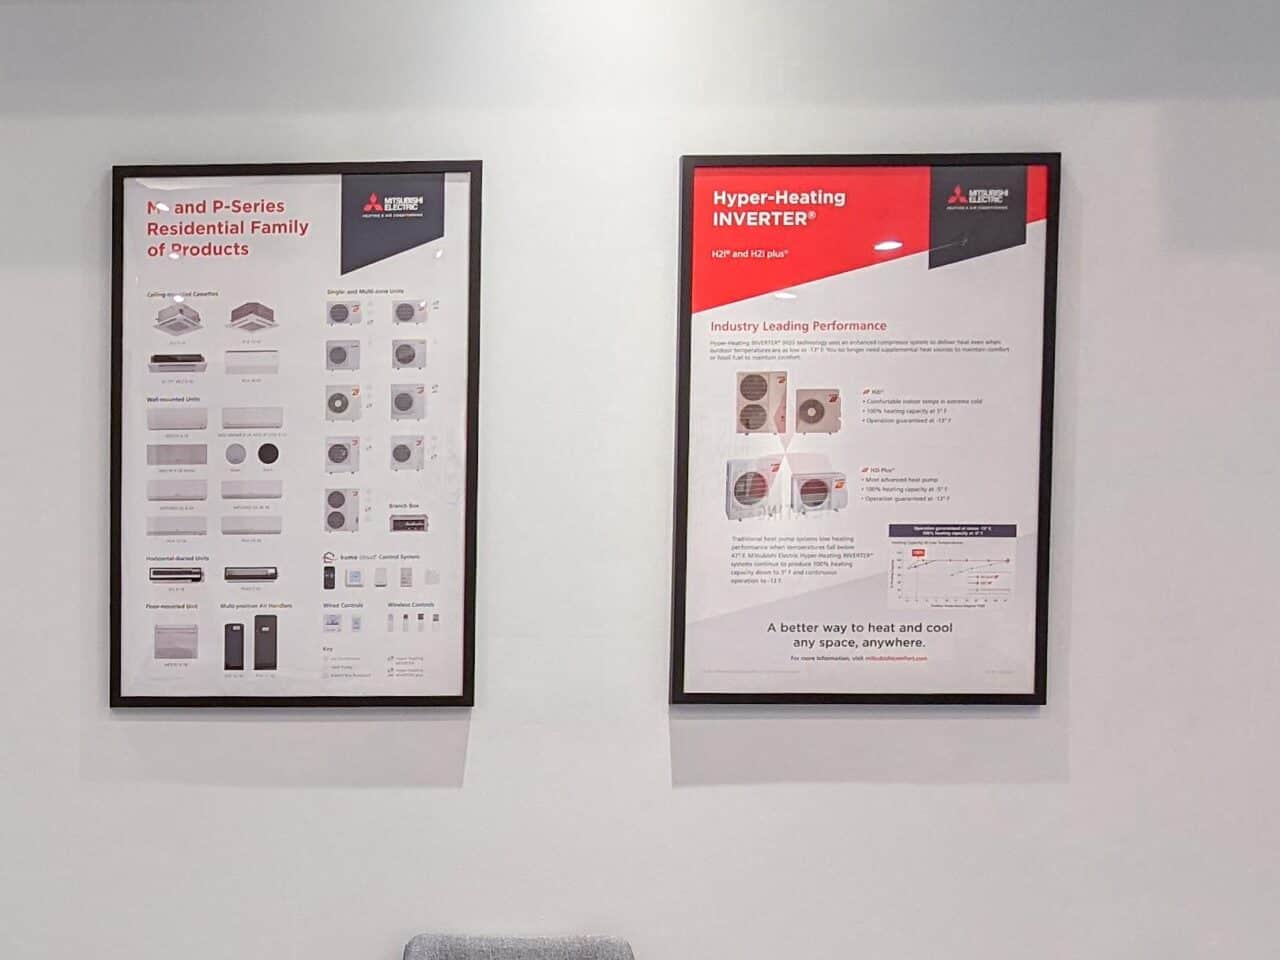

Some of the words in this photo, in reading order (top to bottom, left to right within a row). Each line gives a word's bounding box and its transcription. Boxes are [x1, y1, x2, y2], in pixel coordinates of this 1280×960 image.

[713, 190, 846, 207] Hyper-Heating
[174, 200, 206, 214] and
[213, 199, 285, 213] P-Series
[713, 210, 816, 226] INVERTER®
[148, 220, 244, 235] Residential
[251, 219, 309, 236] Family
[148, 243, 166, 257] of
[171, 242, 249, 256] Products
[732, 249, 749, 258] and
[711, 320, 759, 334] Industry
[762, 320, 809, 334] Leading
[812, 319, 888, 331] Performance
[767, 623, 777, 633] A
[780, 622, 818, 633] better
[822, 625, 848, 635] way
[851, 623, 865, 633] to
[868, 622, 896, 633] heat
[899, 622, 923, 633] and
[926, 622, 953, 633] cool
[793, 639, 815, 649] any
[819, 639, 859, 649] space,
[862, 637, 926, 649] anywhere.
